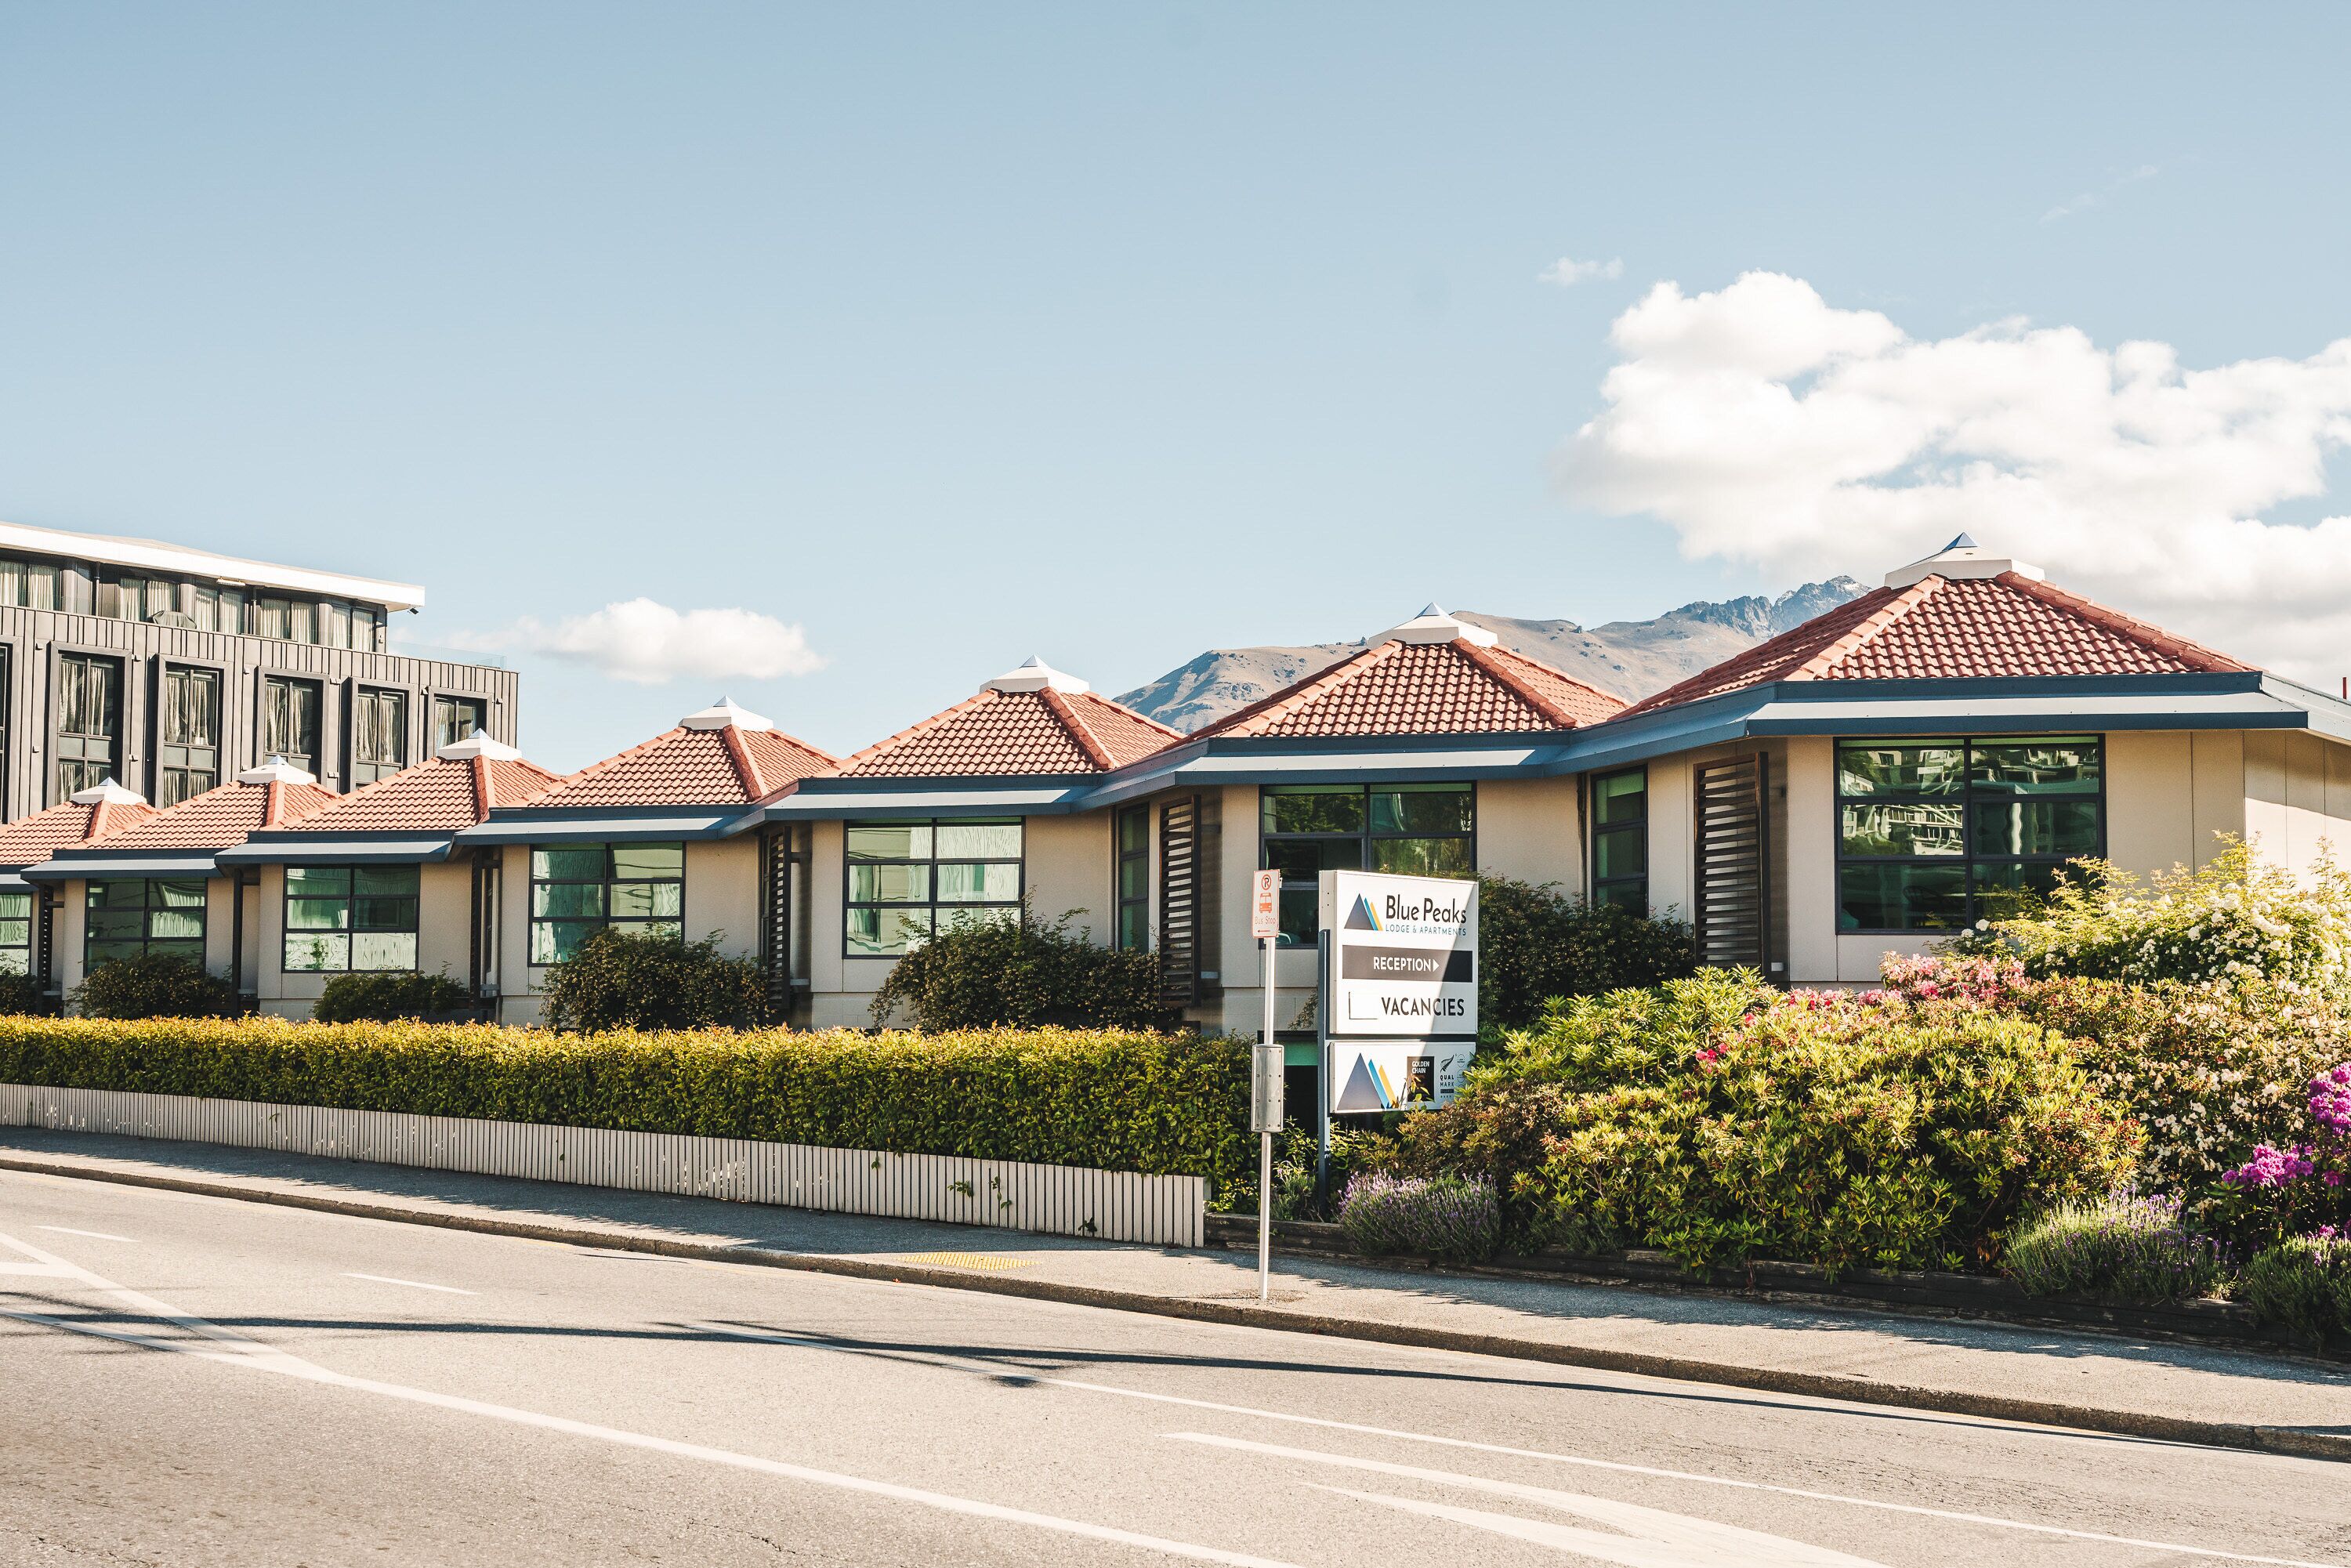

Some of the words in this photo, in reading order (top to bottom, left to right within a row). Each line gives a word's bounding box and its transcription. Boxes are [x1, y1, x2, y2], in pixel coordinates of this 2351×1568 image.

[1386, 894, 1419, 922] Blue
[1423, 897, 1467, 924] Peaks
[1255, 916, 1263, 925] Bus
[1265, 915, 1277, 925] Stop
[1386, 924, 1410, 933] LODGE
[1412, 925, 1417, 933] &
[1419, 926, 1467, 936] APARTMENTS
[1373, 956, 1432, 972] RECEPTION
[1381, 997, 1465, 1016] VACANCIES
